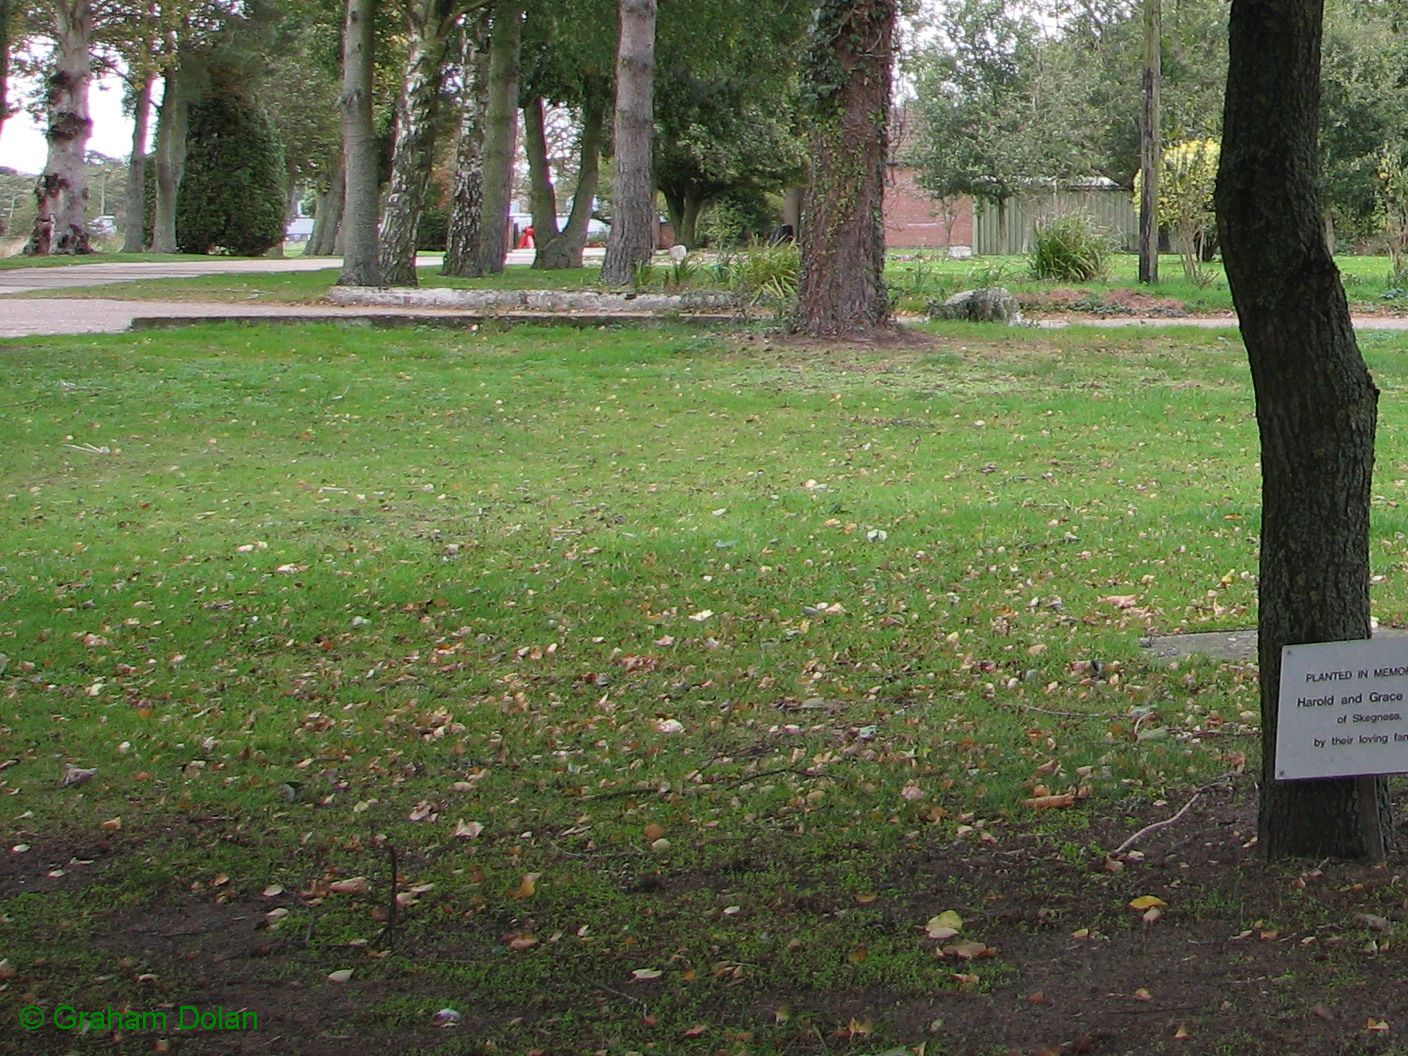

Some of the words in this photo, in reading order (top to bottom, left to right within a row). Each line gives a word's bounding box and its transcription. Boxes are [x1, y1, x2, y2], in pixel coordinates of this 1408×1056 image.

[1306, 671, 1352, 682] PLANTED
[1358, 670, 1368, 678] IN
[1297, 695, 1334, 707] Harold
[1341, 693, 1362, 704] and
[1369, 691, 1403, 702] Grace
[1337, 715, 1346, 724] of
[1314, 737, 1325, 748] by
[1332, 736, 1353, 746] their
[1359, 734, 1388, 744] loving
